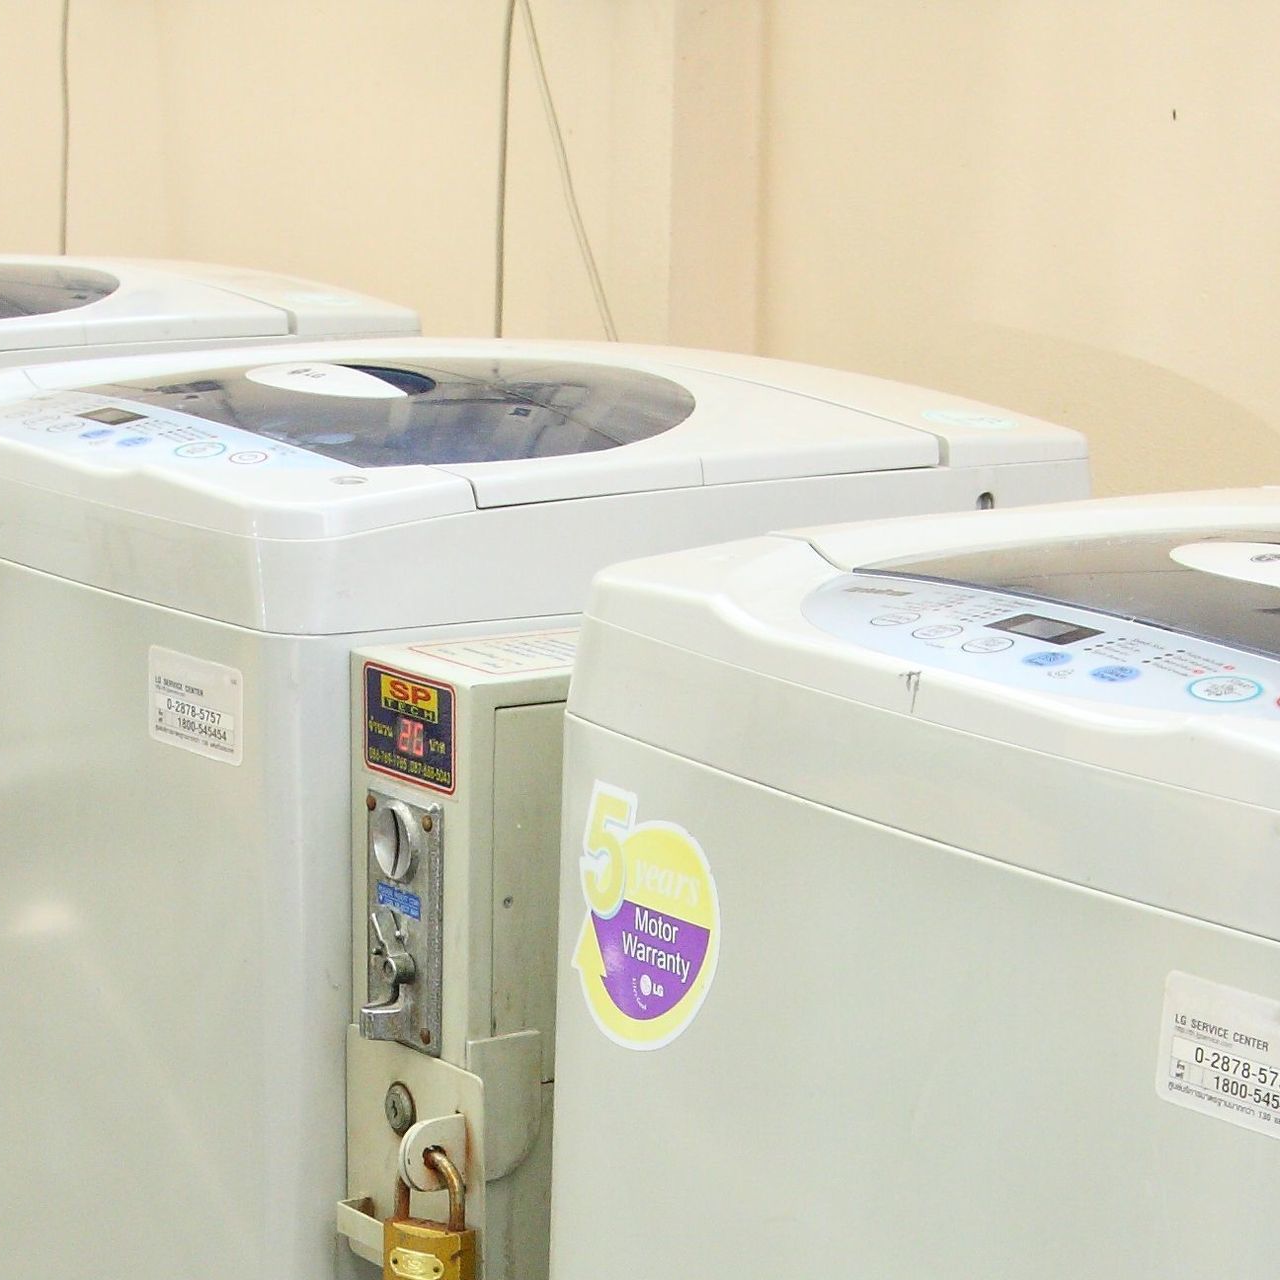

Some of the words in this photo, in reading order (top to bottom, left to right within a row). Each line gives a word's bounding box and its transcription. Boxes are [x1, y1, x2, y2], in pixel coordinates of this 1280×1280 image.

[389, 680, 431, 704] SP
[166, 698, 221, 725] 0-2878-5757
[581, 786, 632, 918] 5
[632, 858, 702, 907] years
[634, 906, 679, 944] Motor
[622, 931, 691, 983] Warranty
[1175, 1013, 1187, 1025] LG
[1191, 1018, 1229, 1039] SERVICE
[1233, 1032, 1269, 1052] CENTER
